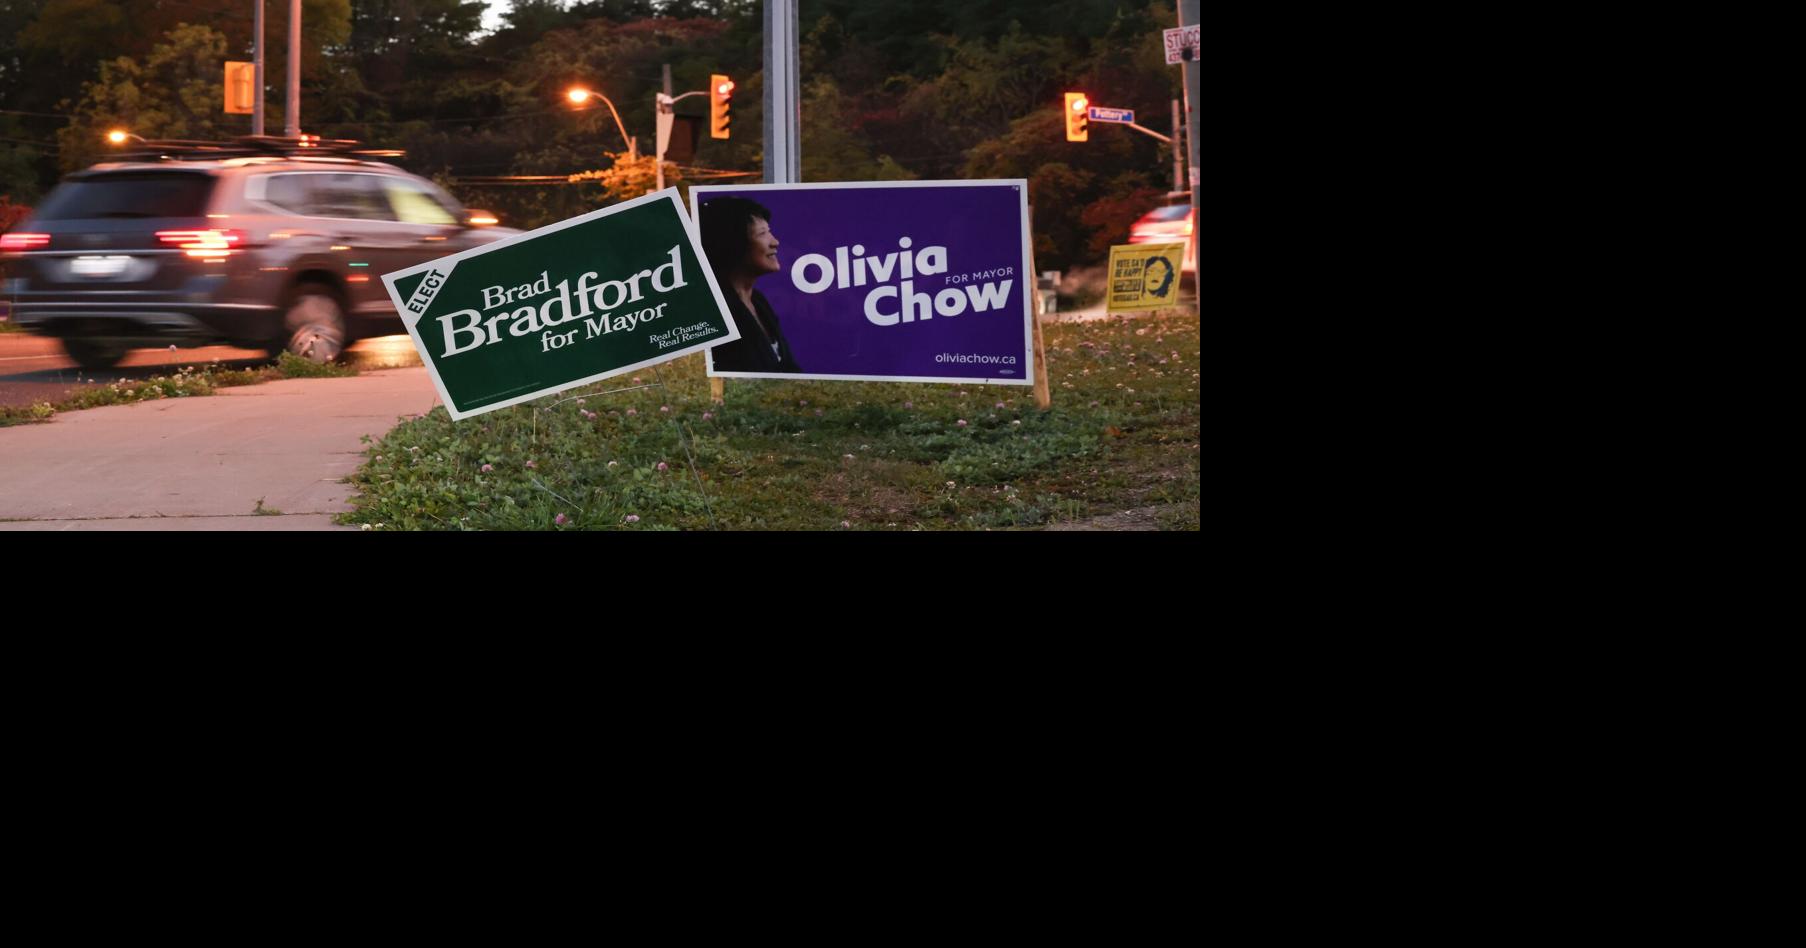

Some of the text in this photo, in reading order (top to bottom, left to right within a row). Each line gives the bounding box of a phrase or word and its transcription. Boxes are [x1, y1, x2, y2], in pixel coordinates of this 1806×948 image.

[790, 236, 948, 294] Olivia
[945, 266, 1013, 285] FOR MAYOR
[408, 269, 445, 314] ELECT
[436, 244, 688, 358] Bradford
[481, 270, 552, 311] Brad
[864, 279, 1013, 326] Chow
[541, 302, 668, 352] for Mayor
[649, 321, 710, 344] Real Change.
[659, 327, 719, 349] Real Results.
[935, 353, 1016, 364] oliviachow.ca
